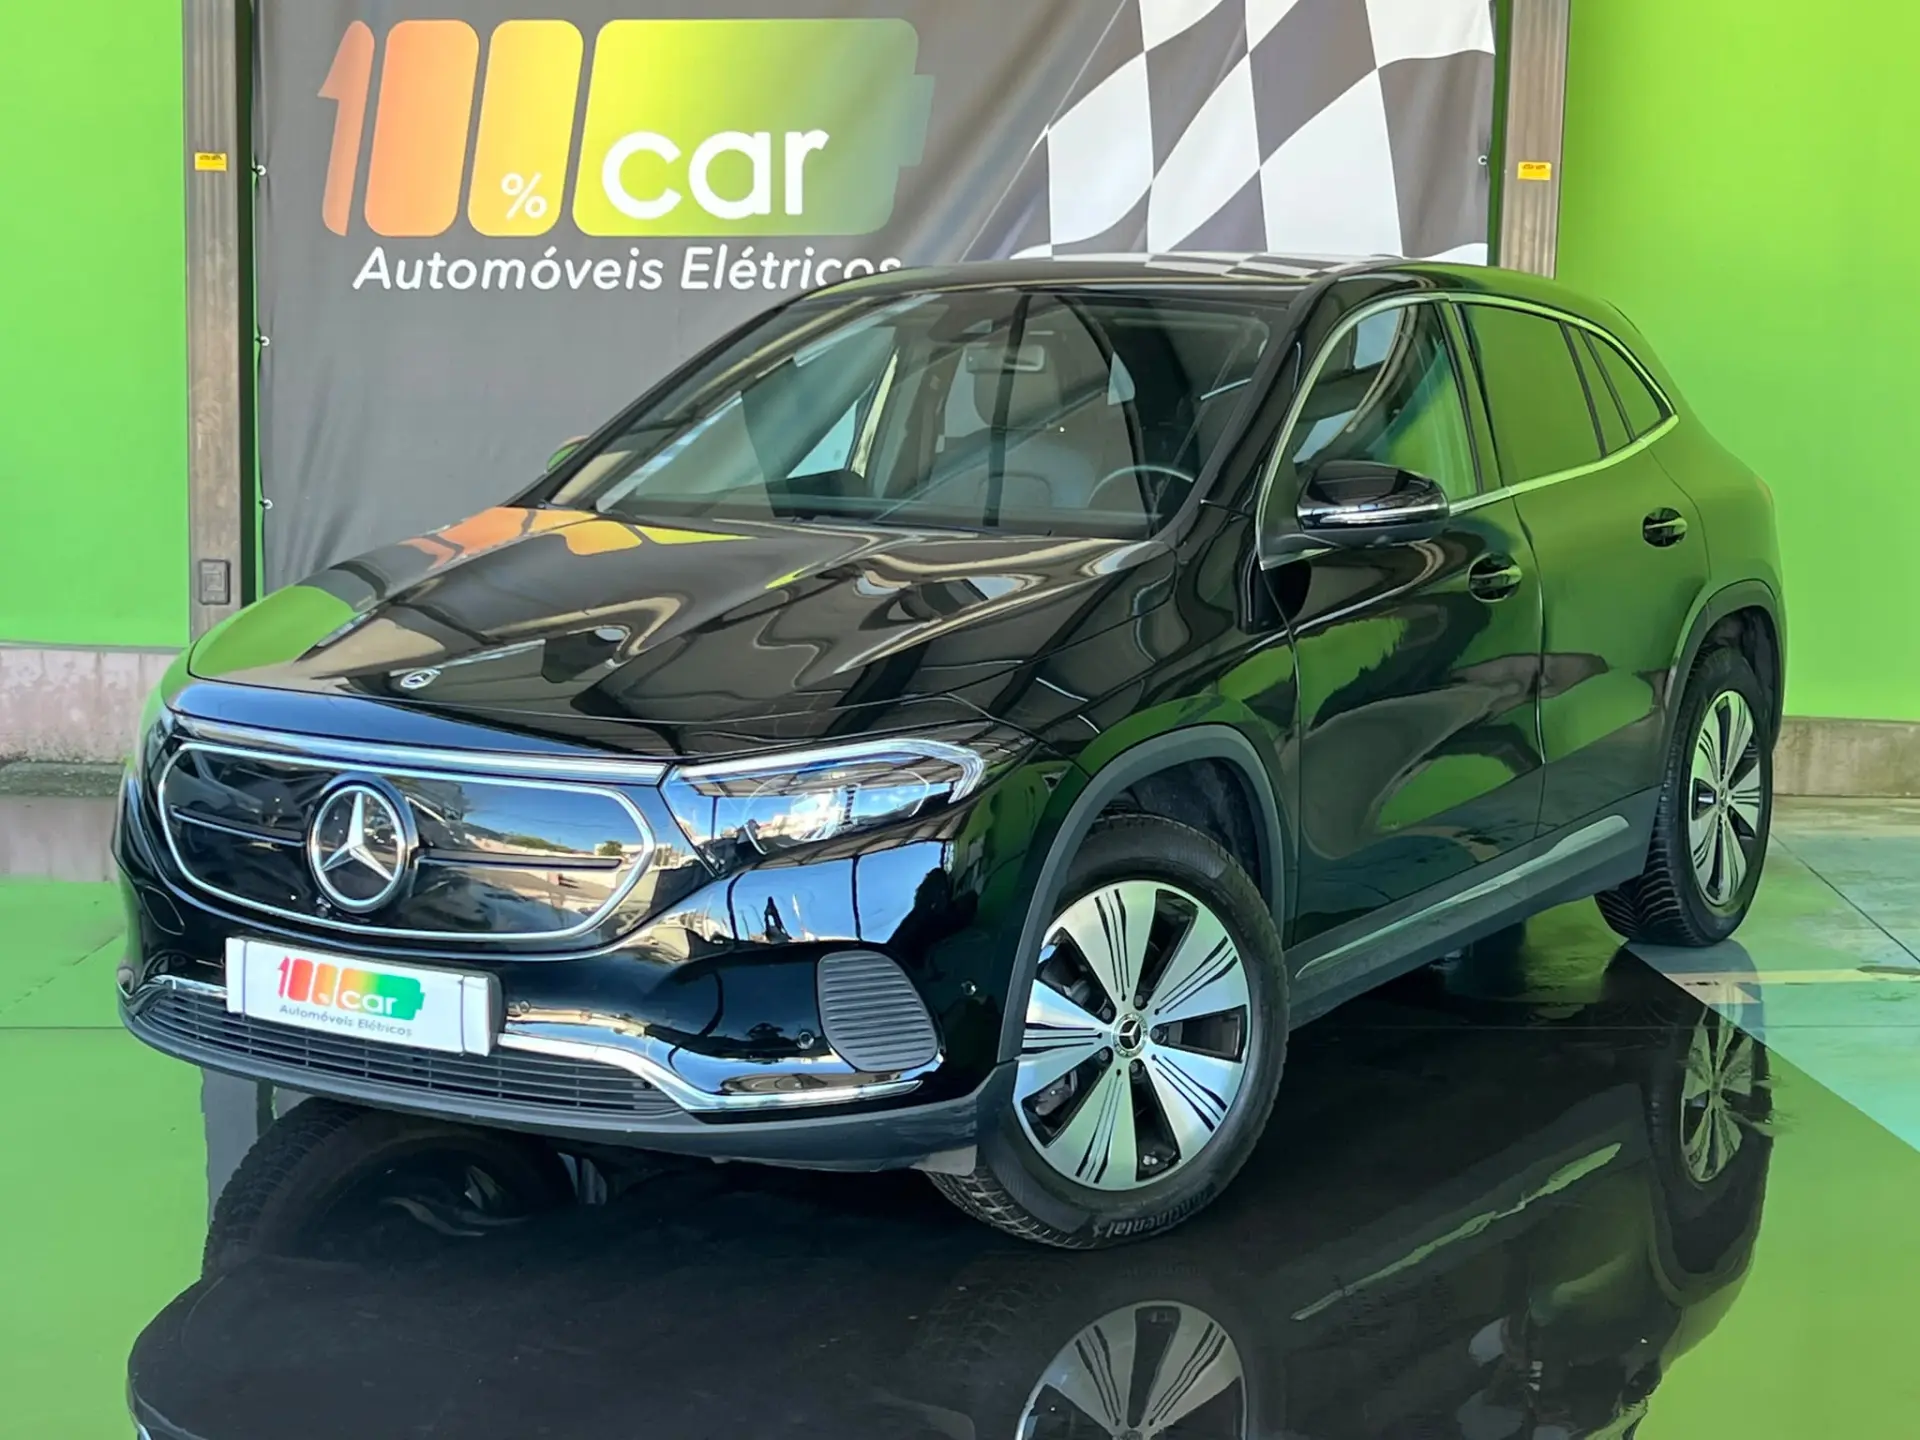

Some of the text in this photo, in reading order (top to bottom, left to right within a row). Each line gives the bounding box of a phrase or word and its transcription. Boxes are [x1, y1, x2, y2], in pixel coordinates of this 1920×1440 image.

[601, 128, 830, 221] car
[351, 244, 664, 291] Automóveis
[279, 1004, 413, 1038] Automóveis Elétricos
[340, 989, 399, 1016] car
